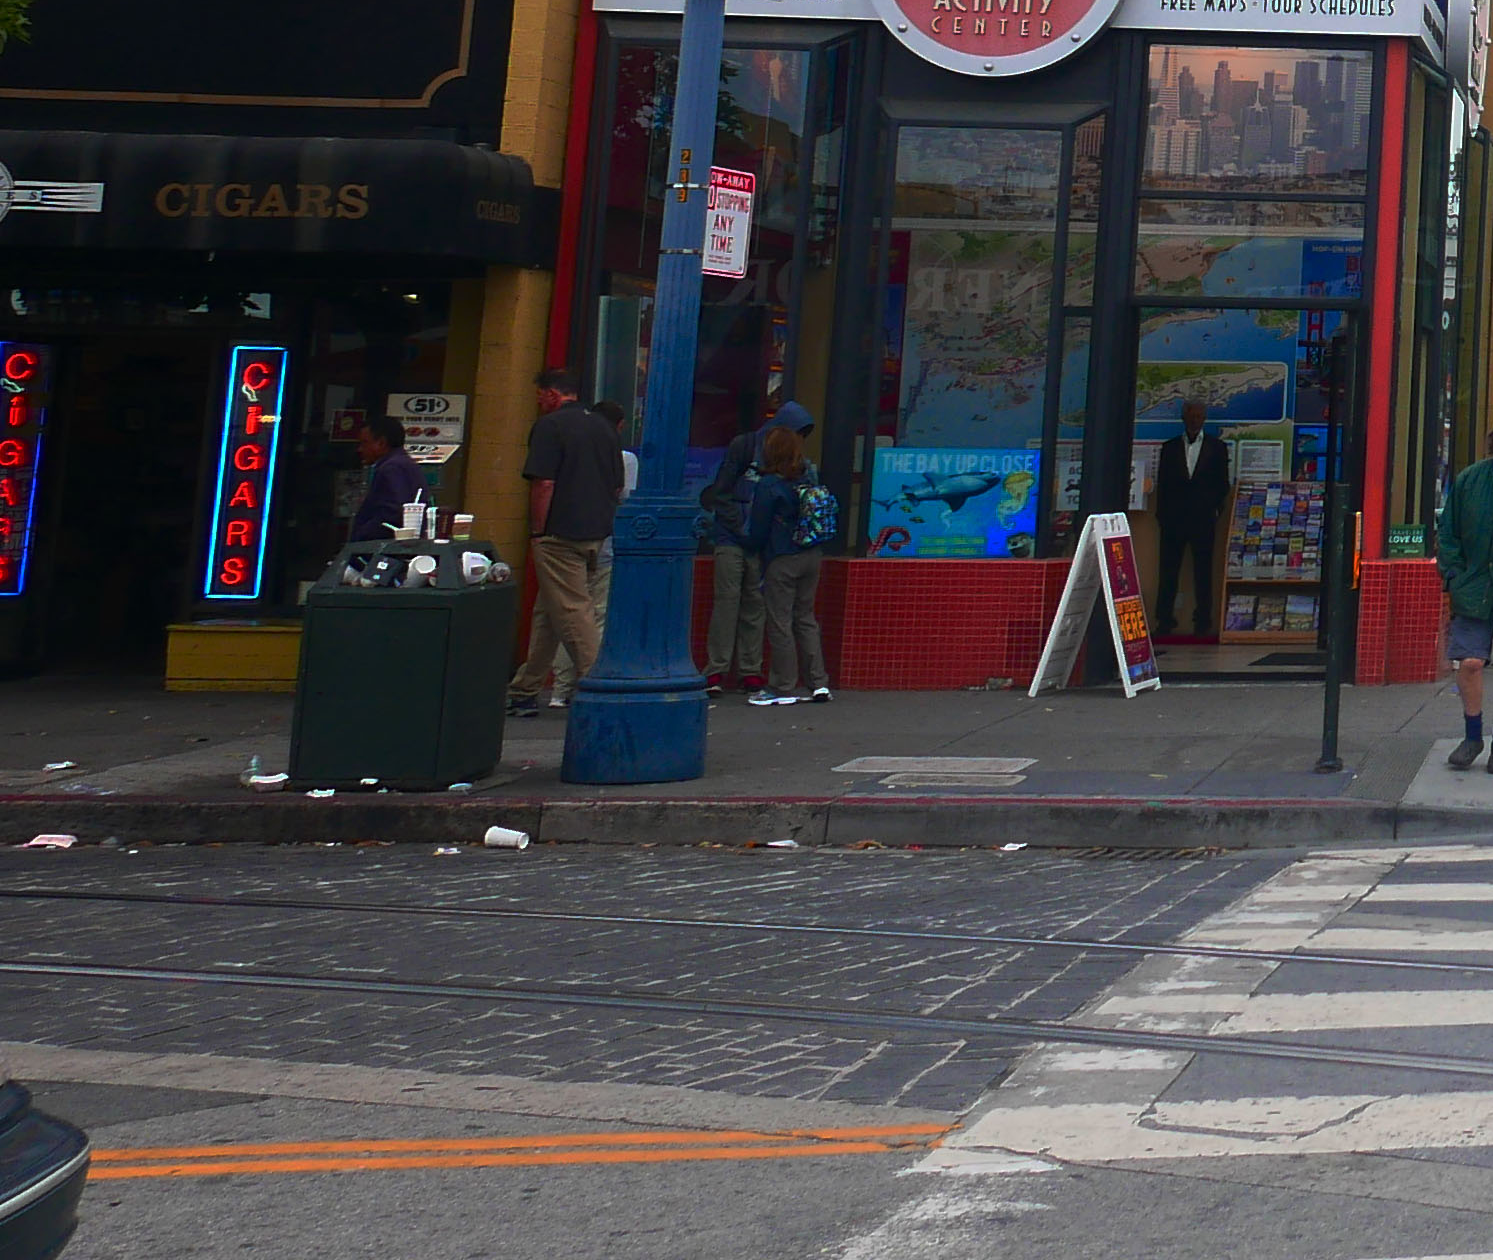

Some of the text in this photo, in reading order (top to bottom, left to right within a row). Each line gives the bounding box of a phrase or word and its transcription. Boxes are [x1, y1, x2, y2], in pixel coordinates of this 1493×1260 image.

[930, 16, 1054, 37] CENTER
[154, 181, 370, 222] CIGARS
[474, 198, 522, 225] CIGARS
[712, 214, 735, 232] ANY
[710, 233, 734, 253] TIME
[882, 452, 1035, 474] THE BAY UP CLOSE
[1388, 535, 1424, 544] LOVE US
[1118, 611, 1148, 641] HERE
